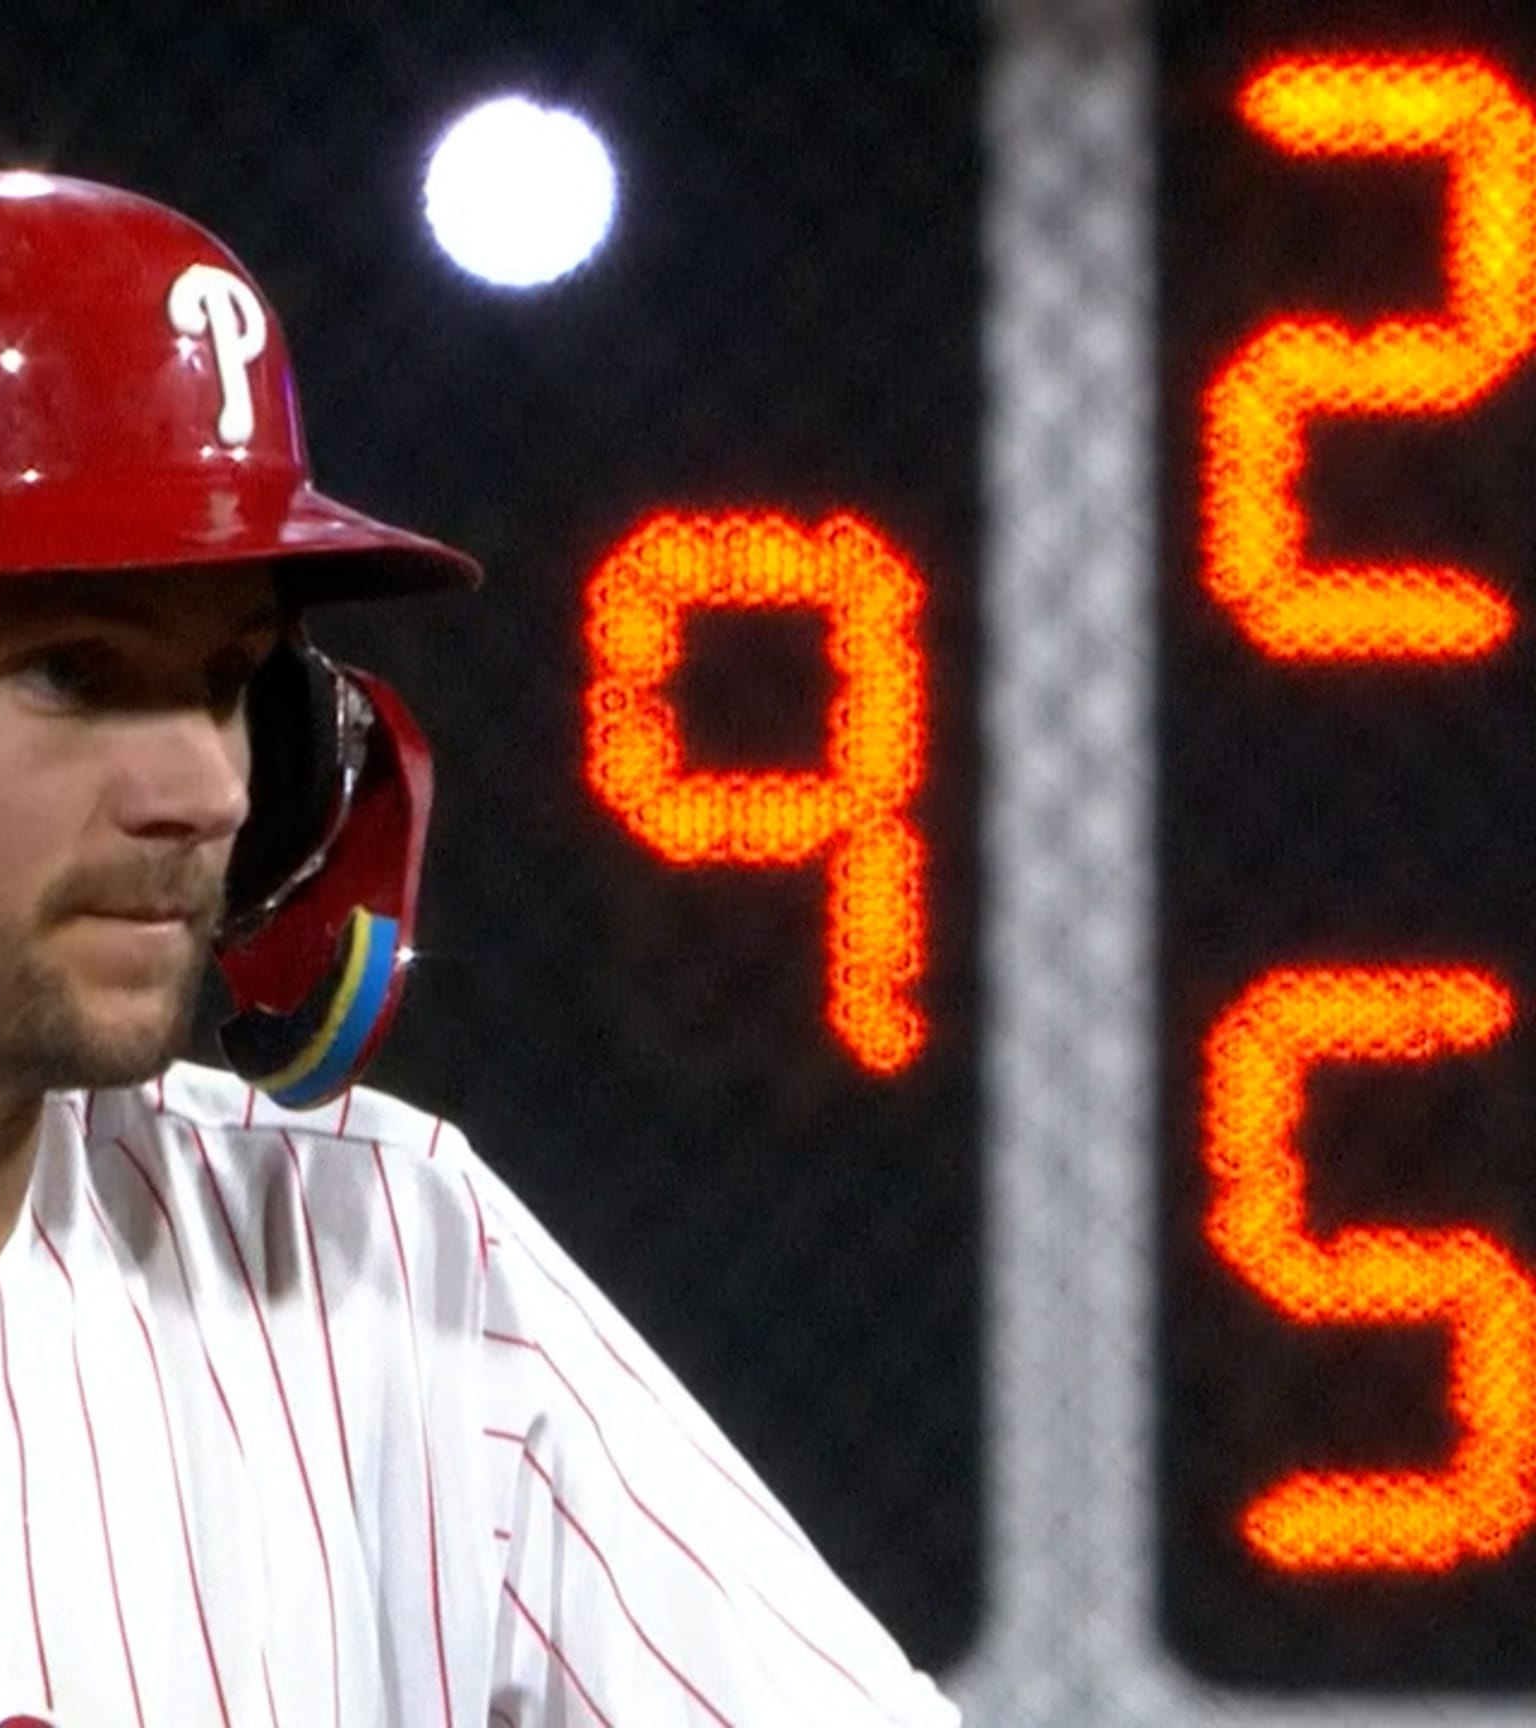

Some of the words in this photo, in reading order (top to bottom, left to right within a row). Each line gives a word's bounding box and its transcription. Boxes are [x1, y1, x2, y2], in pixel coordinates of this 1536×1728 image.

[167, 263, 267, 445] P
[1201, 52, 1536, 662] 2
[582, 510, 928, 1077] 9
[1204, 965, 1536, 1574] 5
